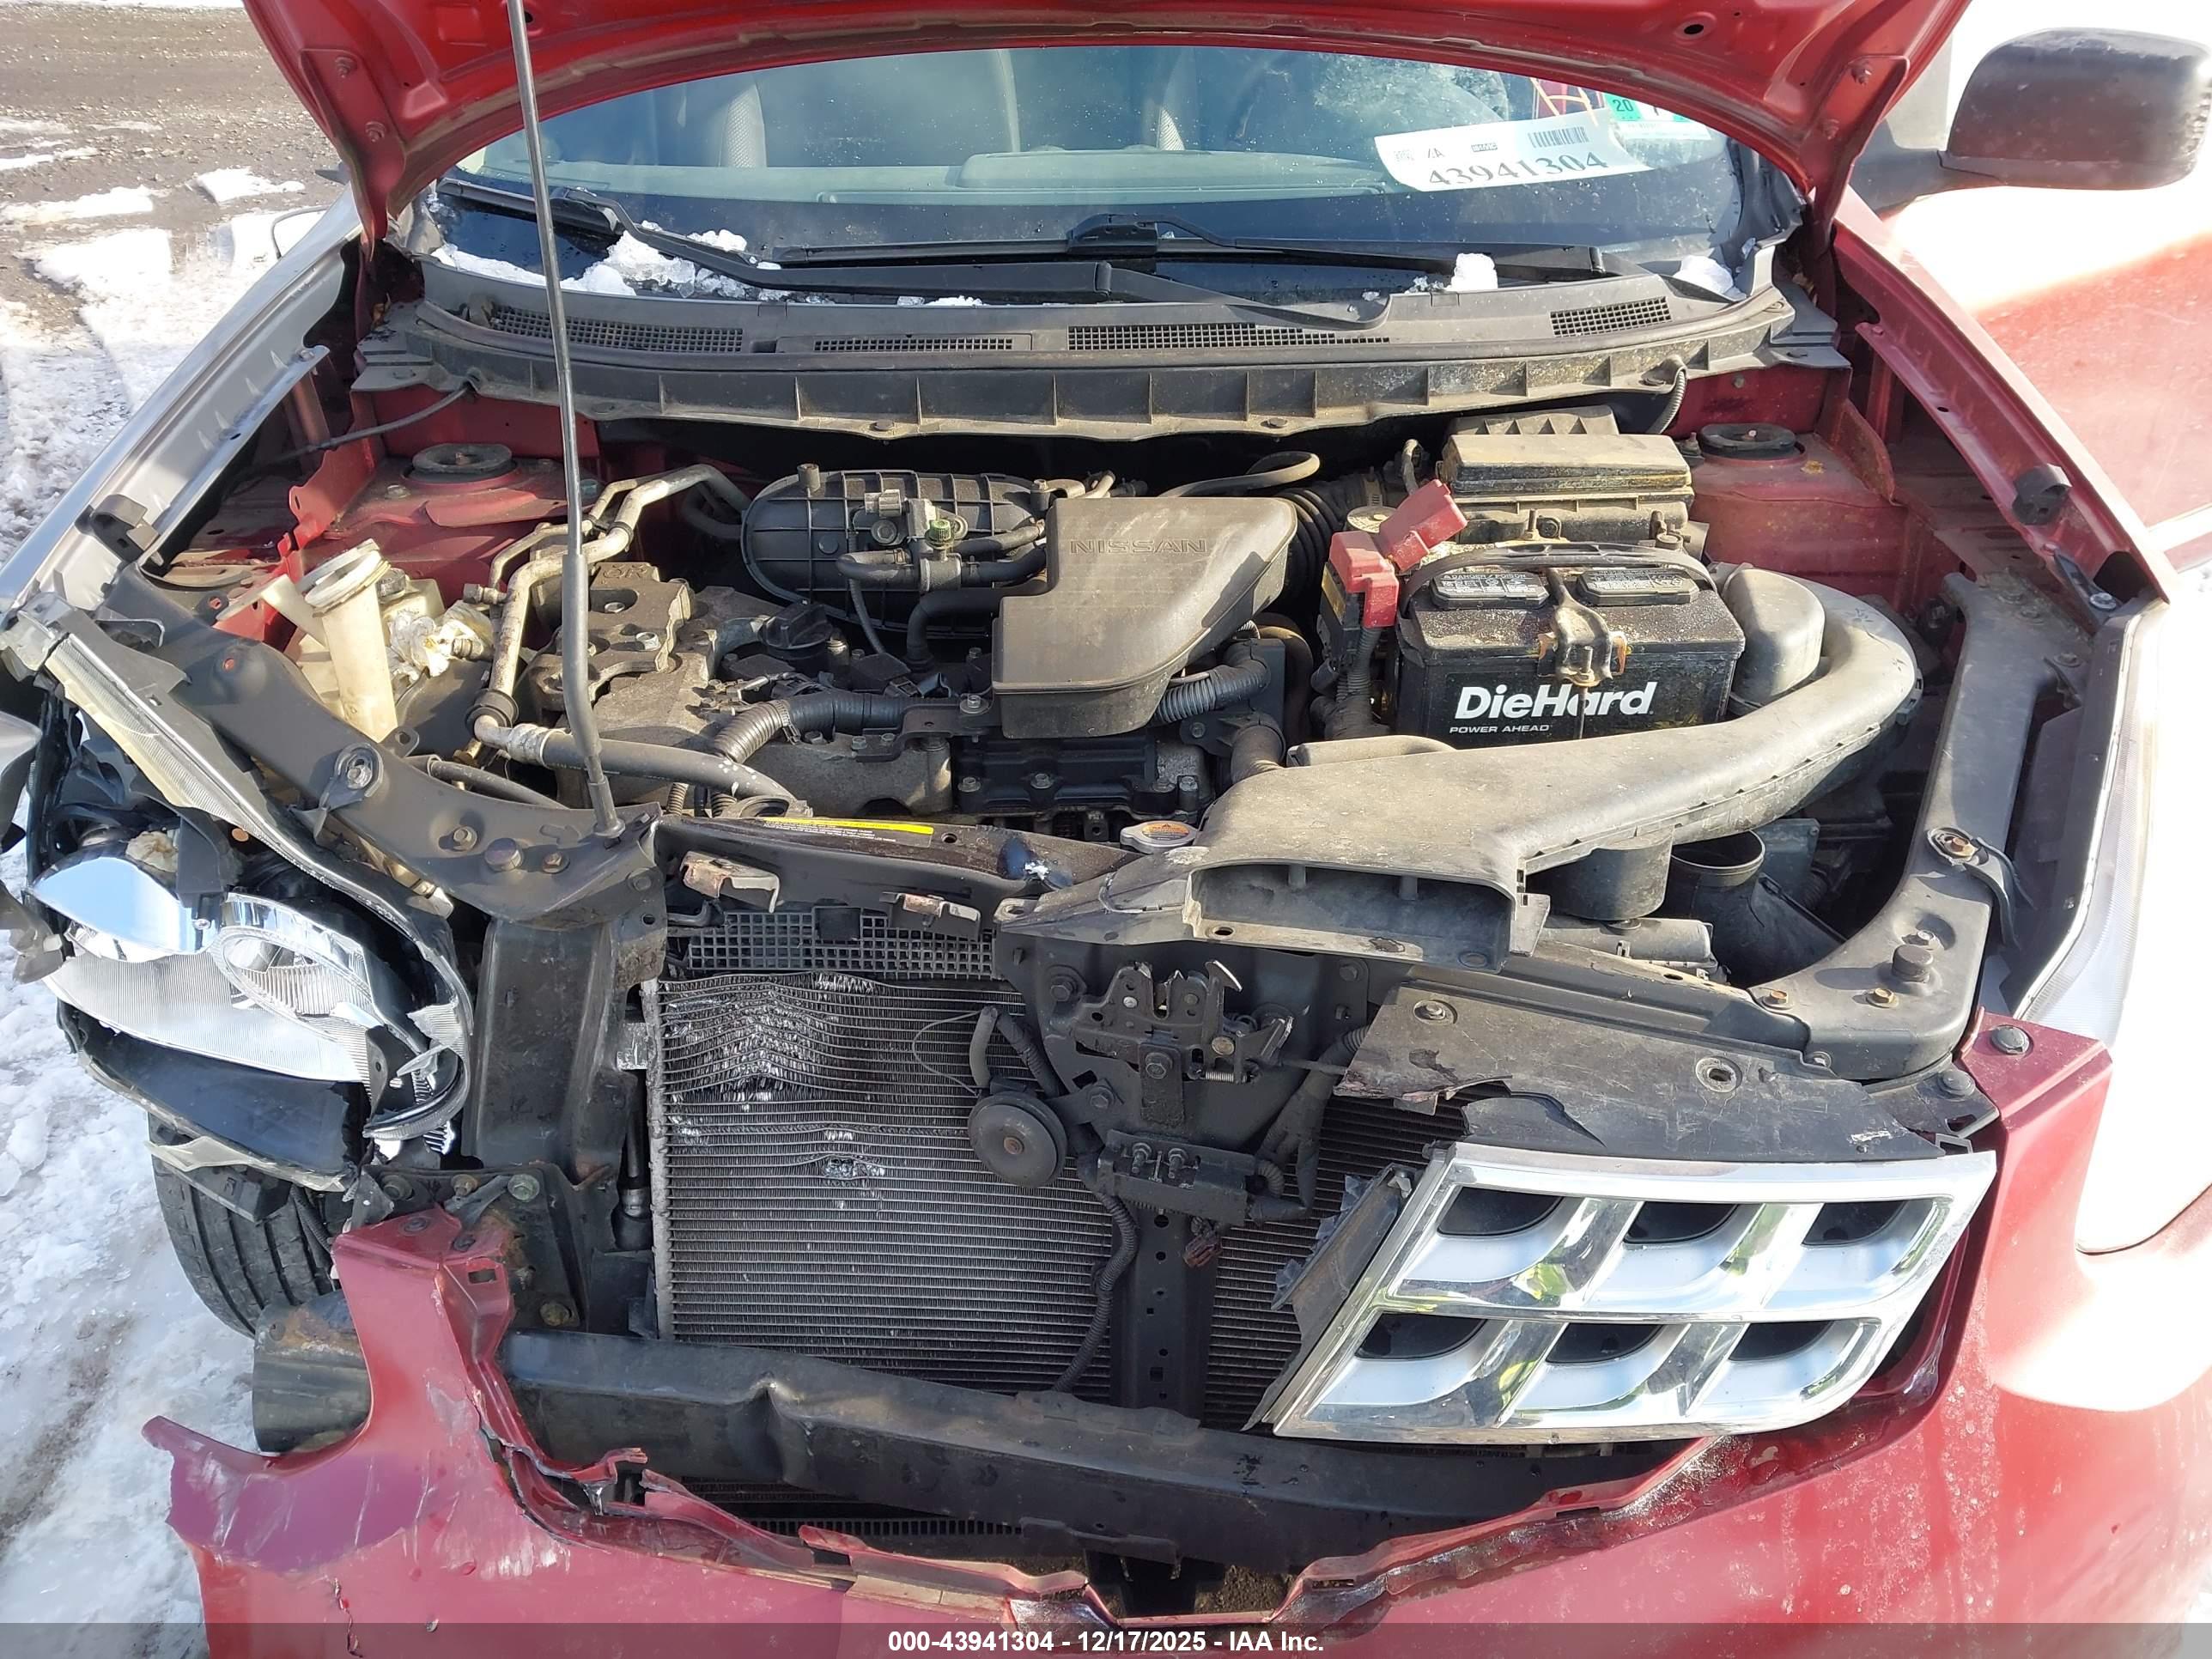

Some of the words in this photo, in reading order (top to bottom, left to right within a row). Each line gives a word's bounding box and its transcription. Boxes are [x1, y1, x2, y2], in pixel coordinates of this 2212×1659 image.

[1613, 99, 1634, 112] 20
[1429, 151, 1609, 185] 43941304
[1070, 539, 1207, 554] NISSAN
[1455, 682, 1658, 720] DieHard
[1449, 726, 1498, 734] POWER
